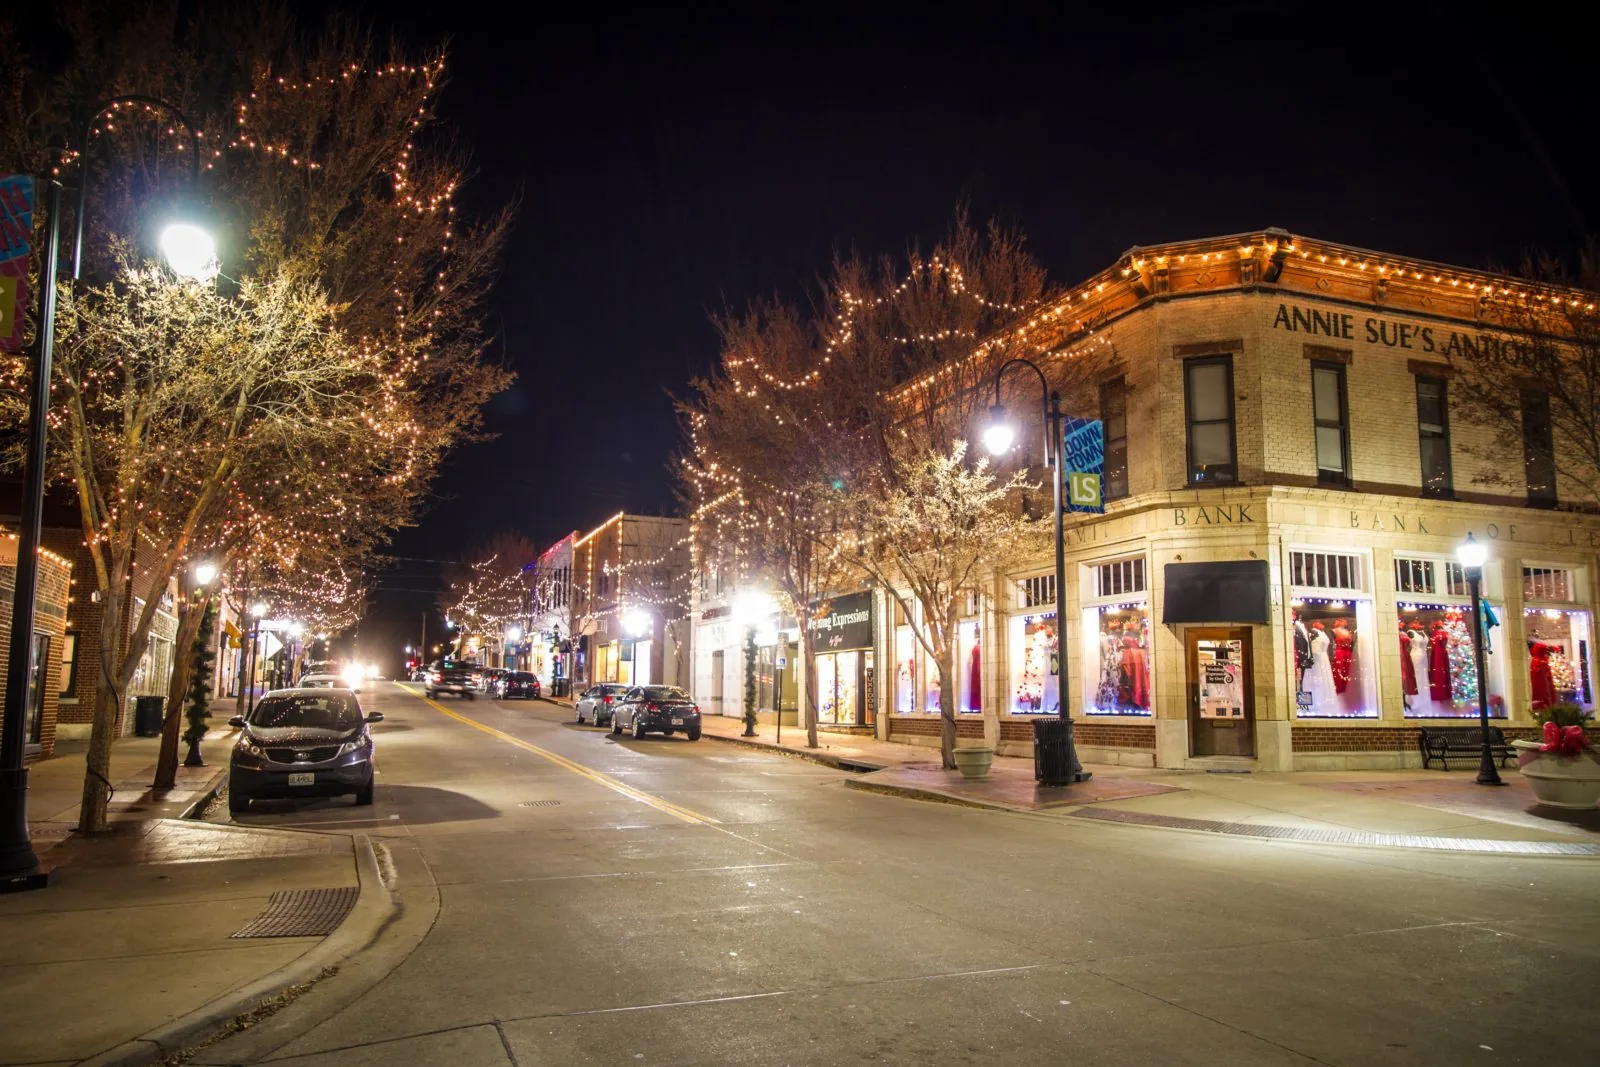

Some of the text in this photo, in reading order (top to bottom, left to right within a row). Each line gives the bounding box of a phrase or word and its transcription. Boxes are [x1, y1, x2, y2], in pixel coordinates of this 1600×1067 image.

[1273, 303, 1354, 340] ANNIE
[1365, 317, 1435, 352] SUE'S
[1064, 424, 1102, 457] DOWN
[1065, 442, 1104, 472] TOWN
[1073, 475, 1097, 503] LS
[1174, 504, 1254, 526] BANK
[1350, 511, 1429, 534] BANK
[1486, 523, 1517, 541] OF
[832, 608, 869, 629] Expressions
